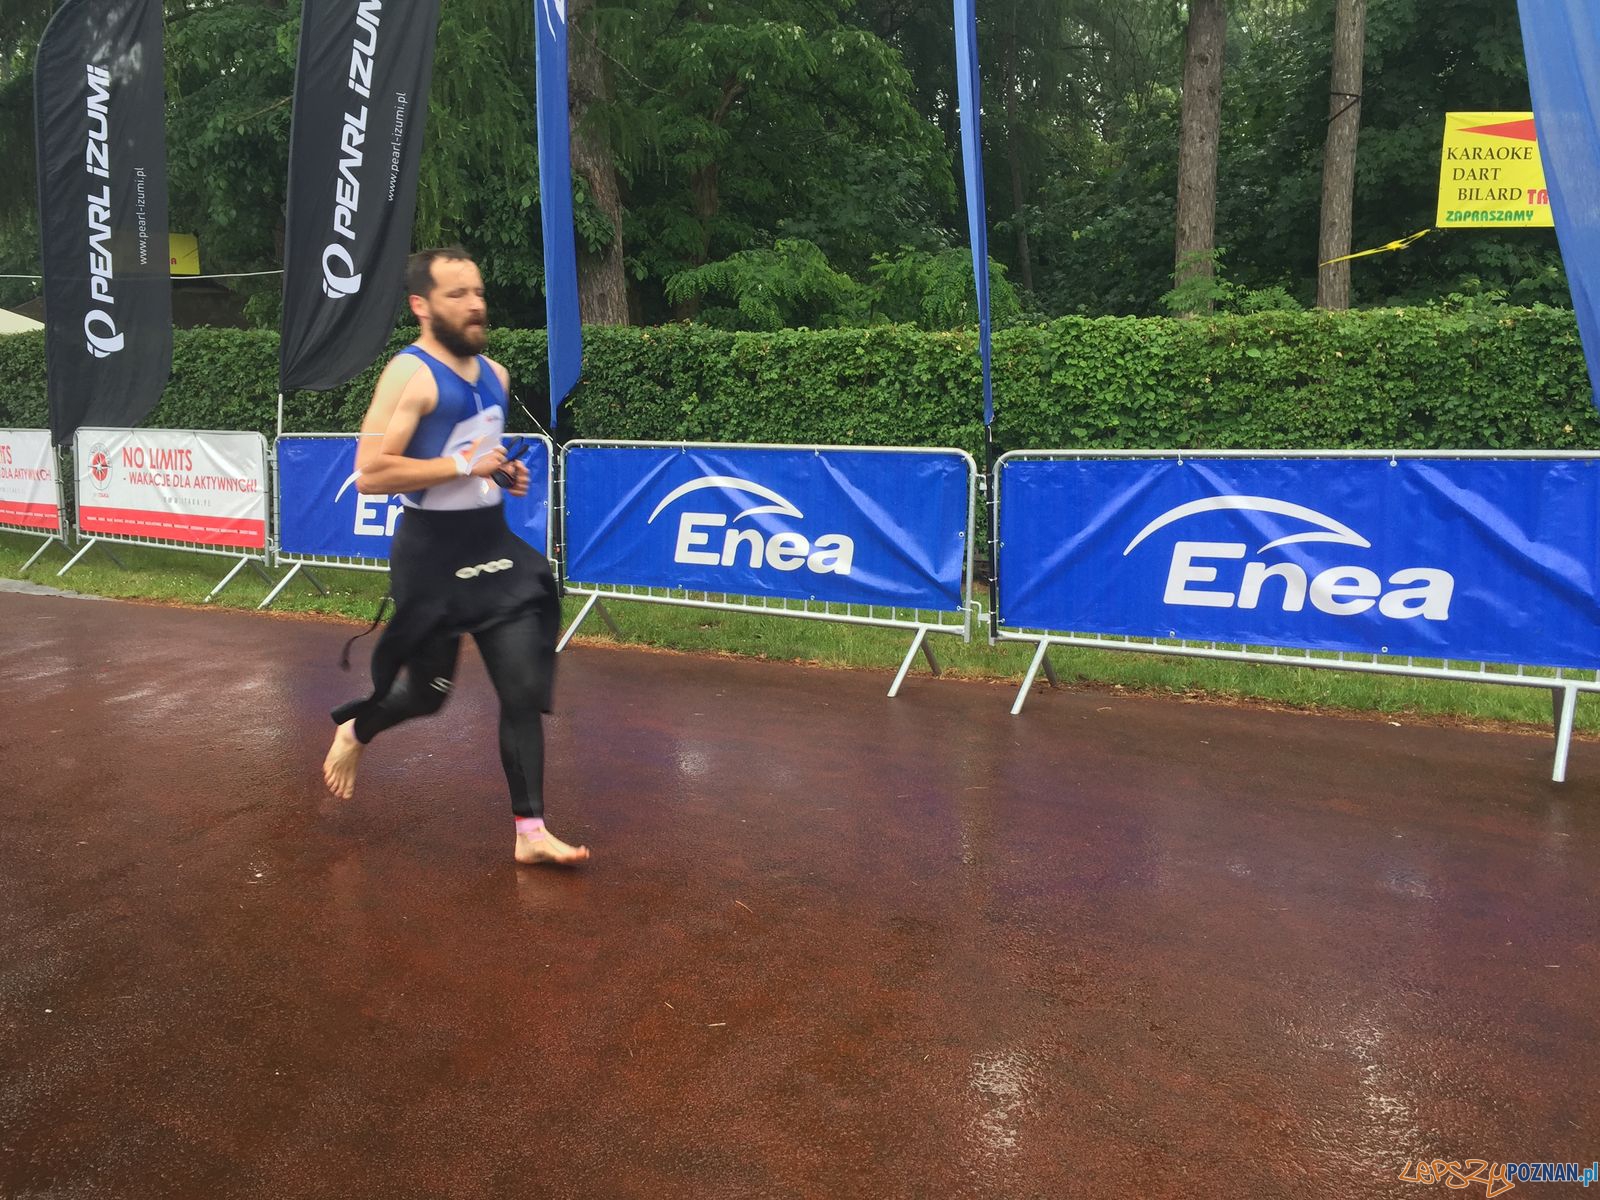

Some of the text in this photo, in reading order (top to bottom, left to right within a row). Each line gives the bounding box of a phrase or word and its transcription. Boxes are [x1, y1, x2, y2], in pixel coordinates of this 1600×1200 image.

[388, 91, 407, 202] www.pearl-izumi.pl
[1446, 146, 1533, 161] KARAOKE
[333, 105, 368, 240] PEARL
[1452, 167, 1502, 181] DART
[1457, 187, 1522, 201] BILARD
[135, 166, 149, 265] www.pearl-izumi.pl
[1445, 210, 1534, 222] ZAPRASZAMY
[88, 185, 115, 304] PEARL
[122, 446, 145, 469] NO
[149, 447, 193, 472] LIMITS
[129, 471, 171, 487] WAKACJE
[173, 474, 191, 489] DLA
[193, 475, 257, 493] AKTYWNYCH!
[674, 511, 855, 575] Enea
[1163, 541, 1455, 621] Enea
